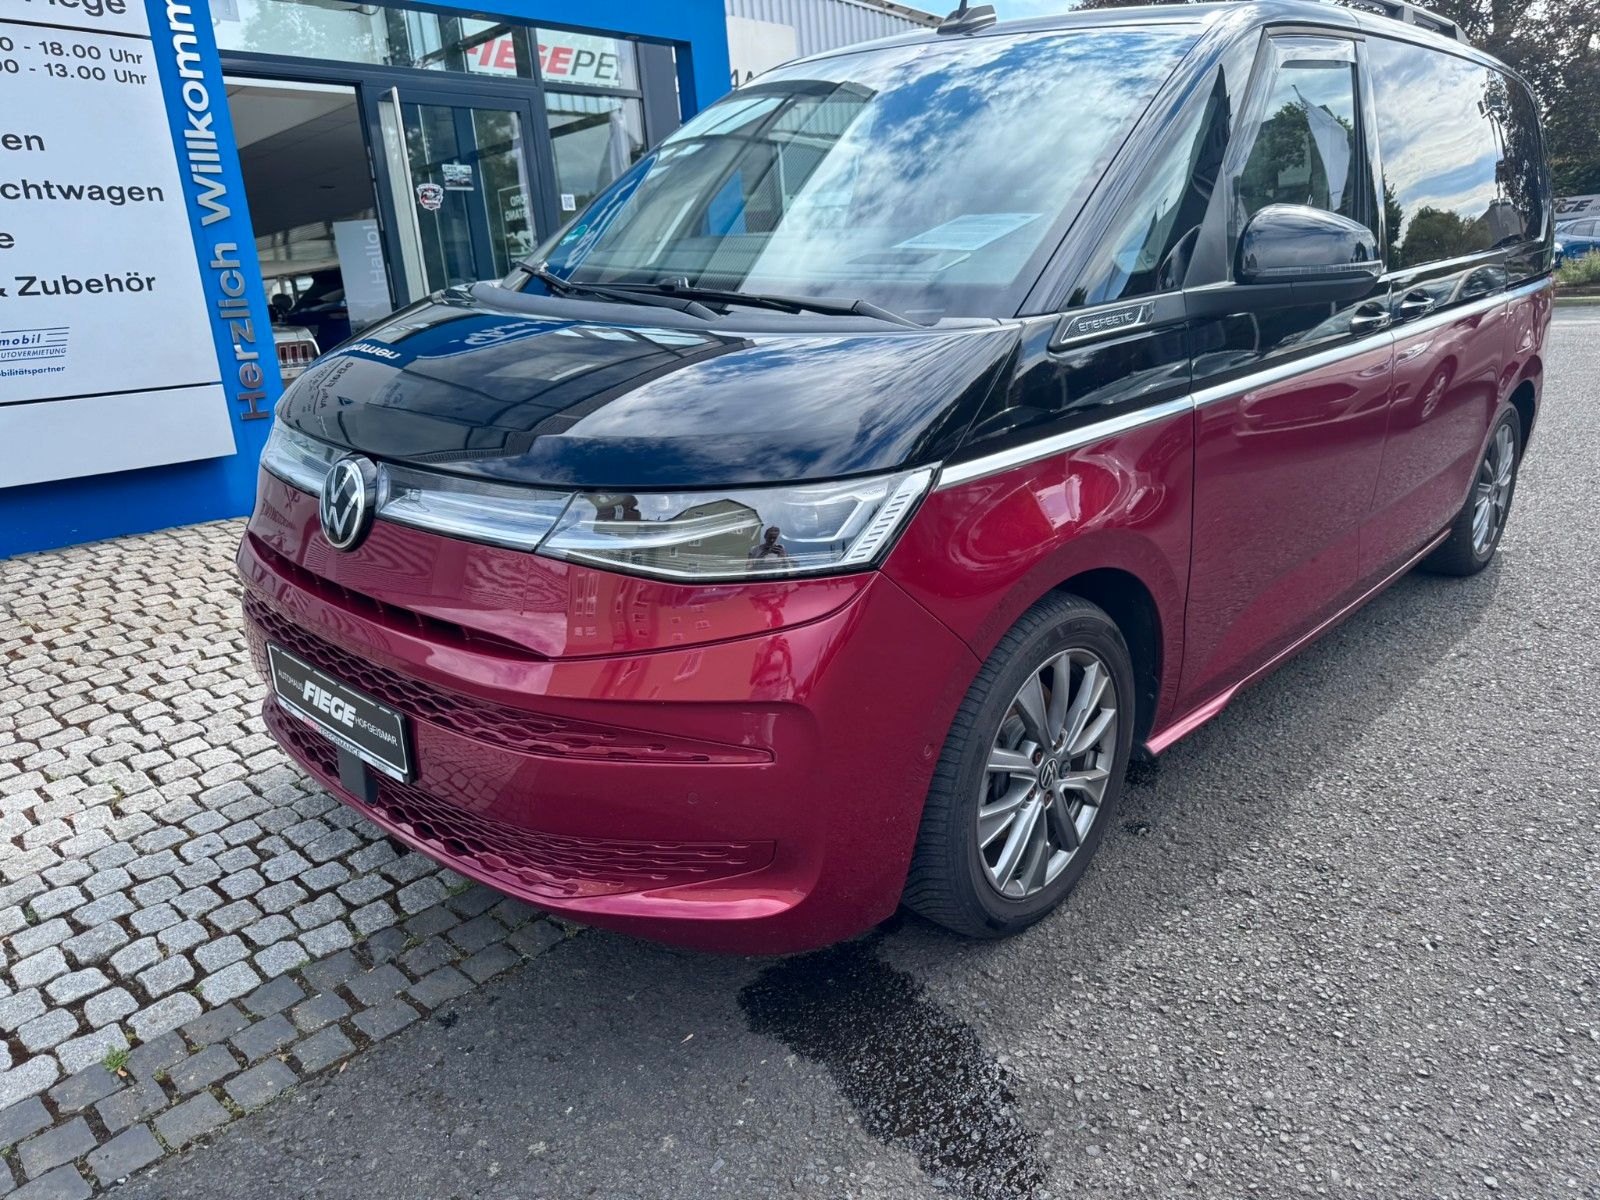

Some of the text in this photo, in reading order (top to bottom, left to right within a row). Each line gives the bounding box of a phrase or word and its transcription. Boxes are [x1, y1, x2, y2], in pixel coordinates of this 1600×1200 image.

[39, 41, 101, 60] 18.00
[109, 48, 143, 64] Uhr
[0, 59, 20, 74] 0
[44, 63, 106, 81] 13.00
[114, 69, 147, 84] Uhr
[1, 133, 45, 151] en
[0, 179, 165, 206] chtwagen
[15, 272, 156, 297] Zubehör
[210, 242, 271, 421] Herzlich
[0, 366, 66, 377] bilitätspartner
[303, 680, 357, 728] FIEGE
[354, 715, 398, 747] HOFGEISMAR
